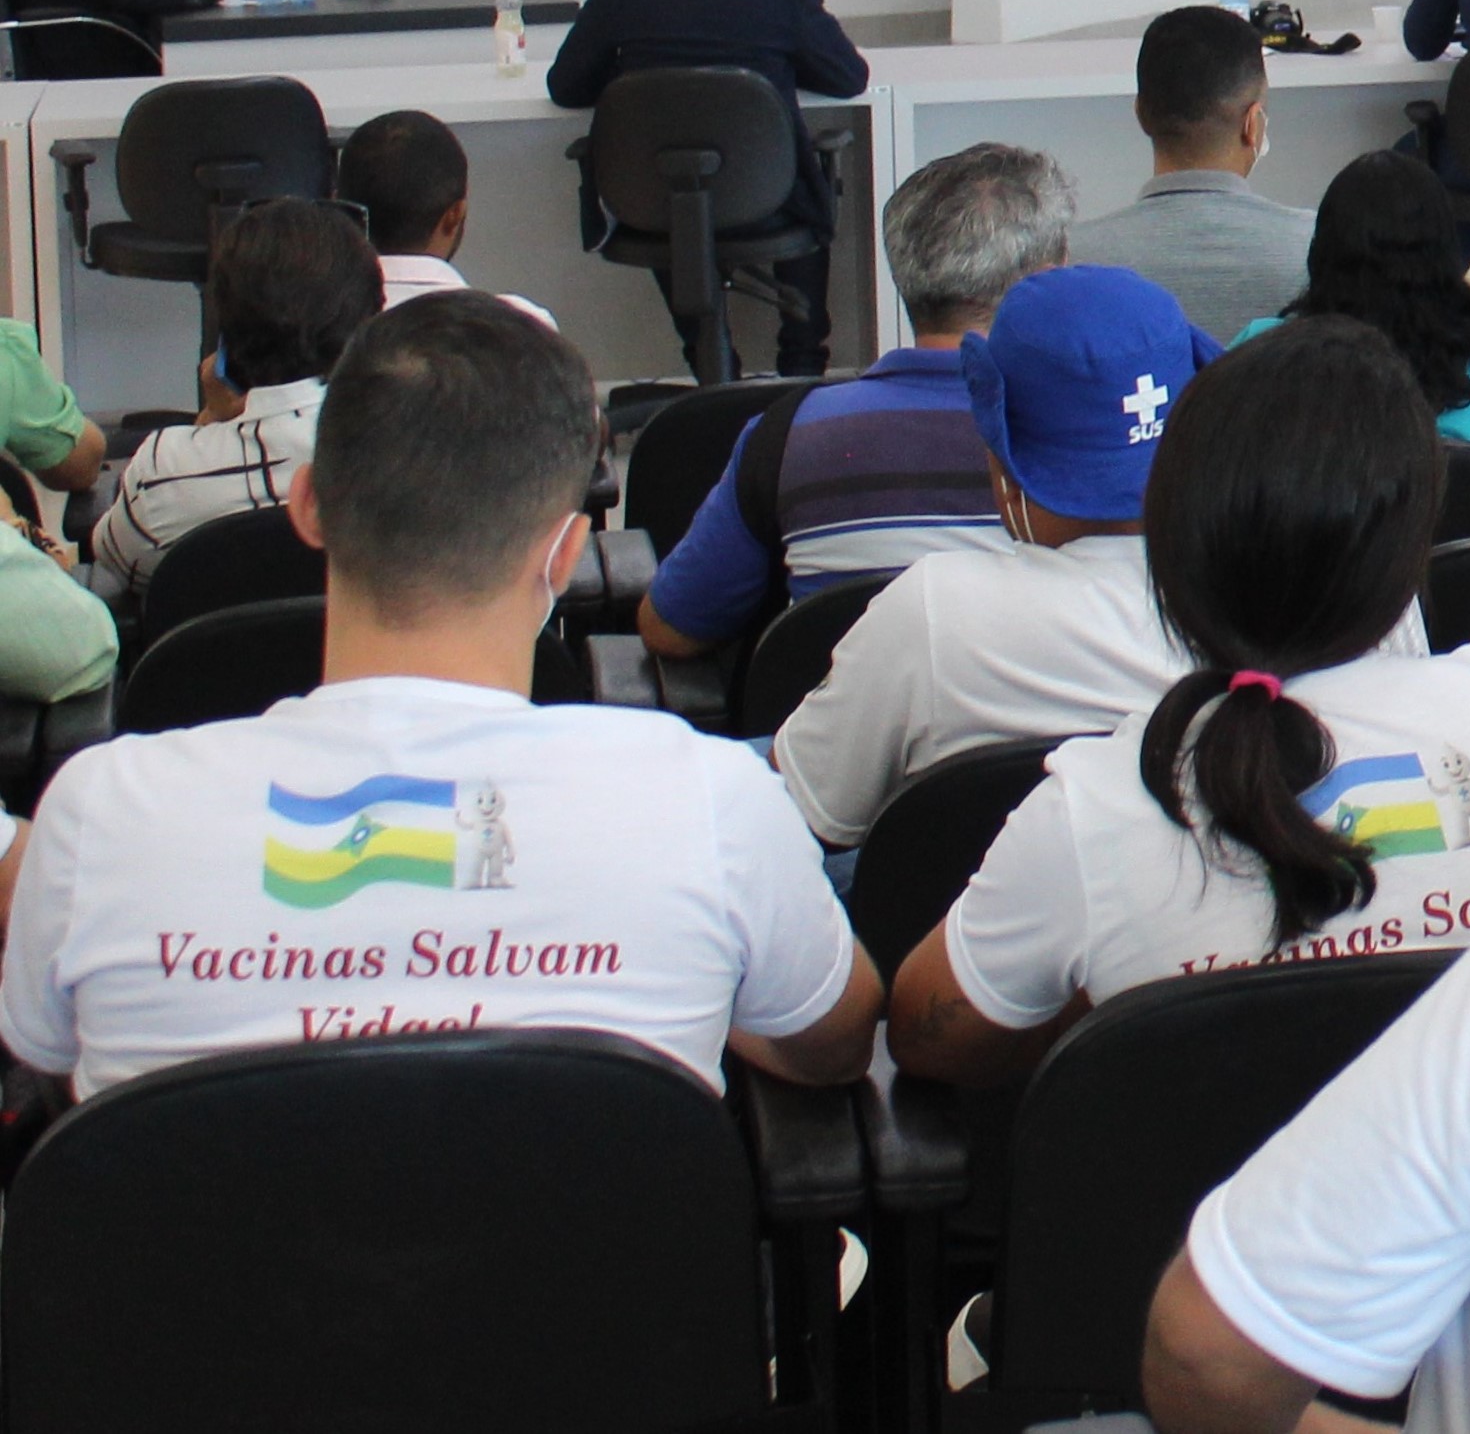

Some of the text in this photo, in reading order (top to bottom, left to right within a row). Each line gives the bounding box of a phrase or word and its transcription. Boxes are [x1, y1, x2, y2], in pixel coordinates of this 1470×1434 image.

[1129, 418, 1165, 444] SUS
[157, 927, 623, 982] Vacinas Salvam
